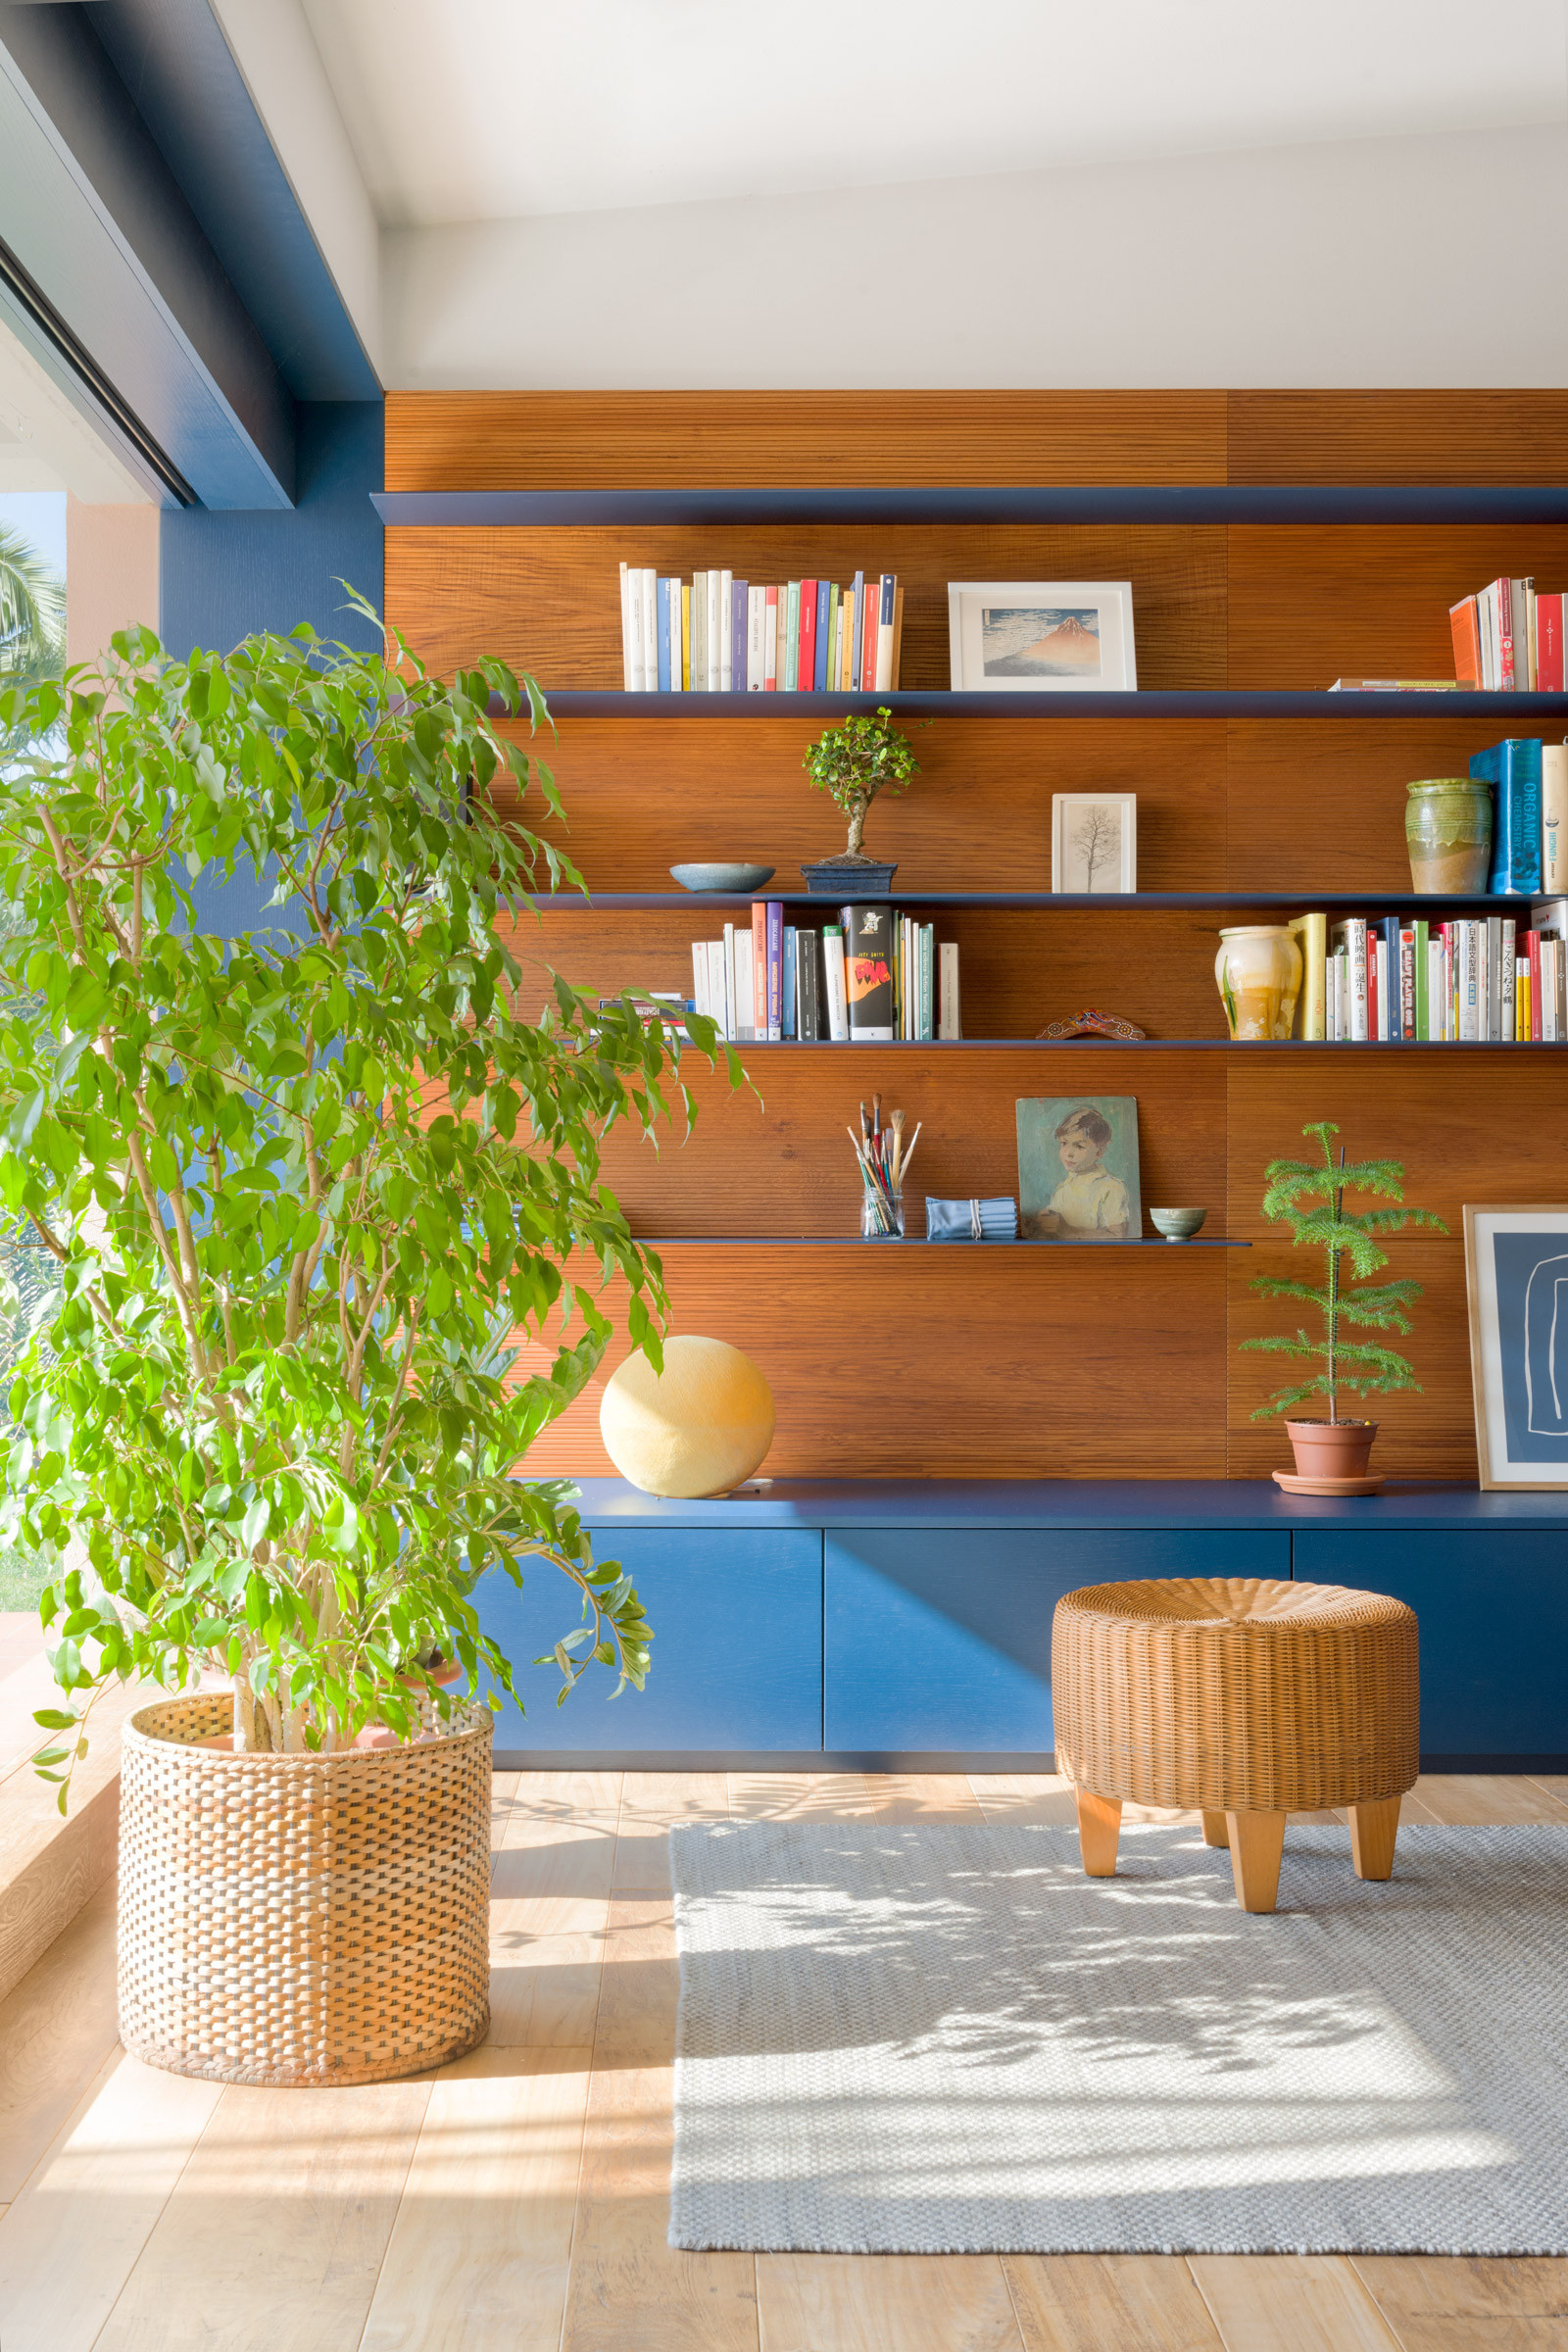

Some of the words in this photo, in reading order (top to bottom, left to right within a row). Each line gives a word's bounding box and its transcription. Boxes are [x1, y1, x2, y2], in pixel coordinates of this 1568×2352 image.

[1513, 796, 1522, 848] CHEMISTRY
[1524, 783, 1537, 849] ORGANIC
[856, 960, 888, 985] BONE
[1404, 978, 1413, 1008] PLAYER
